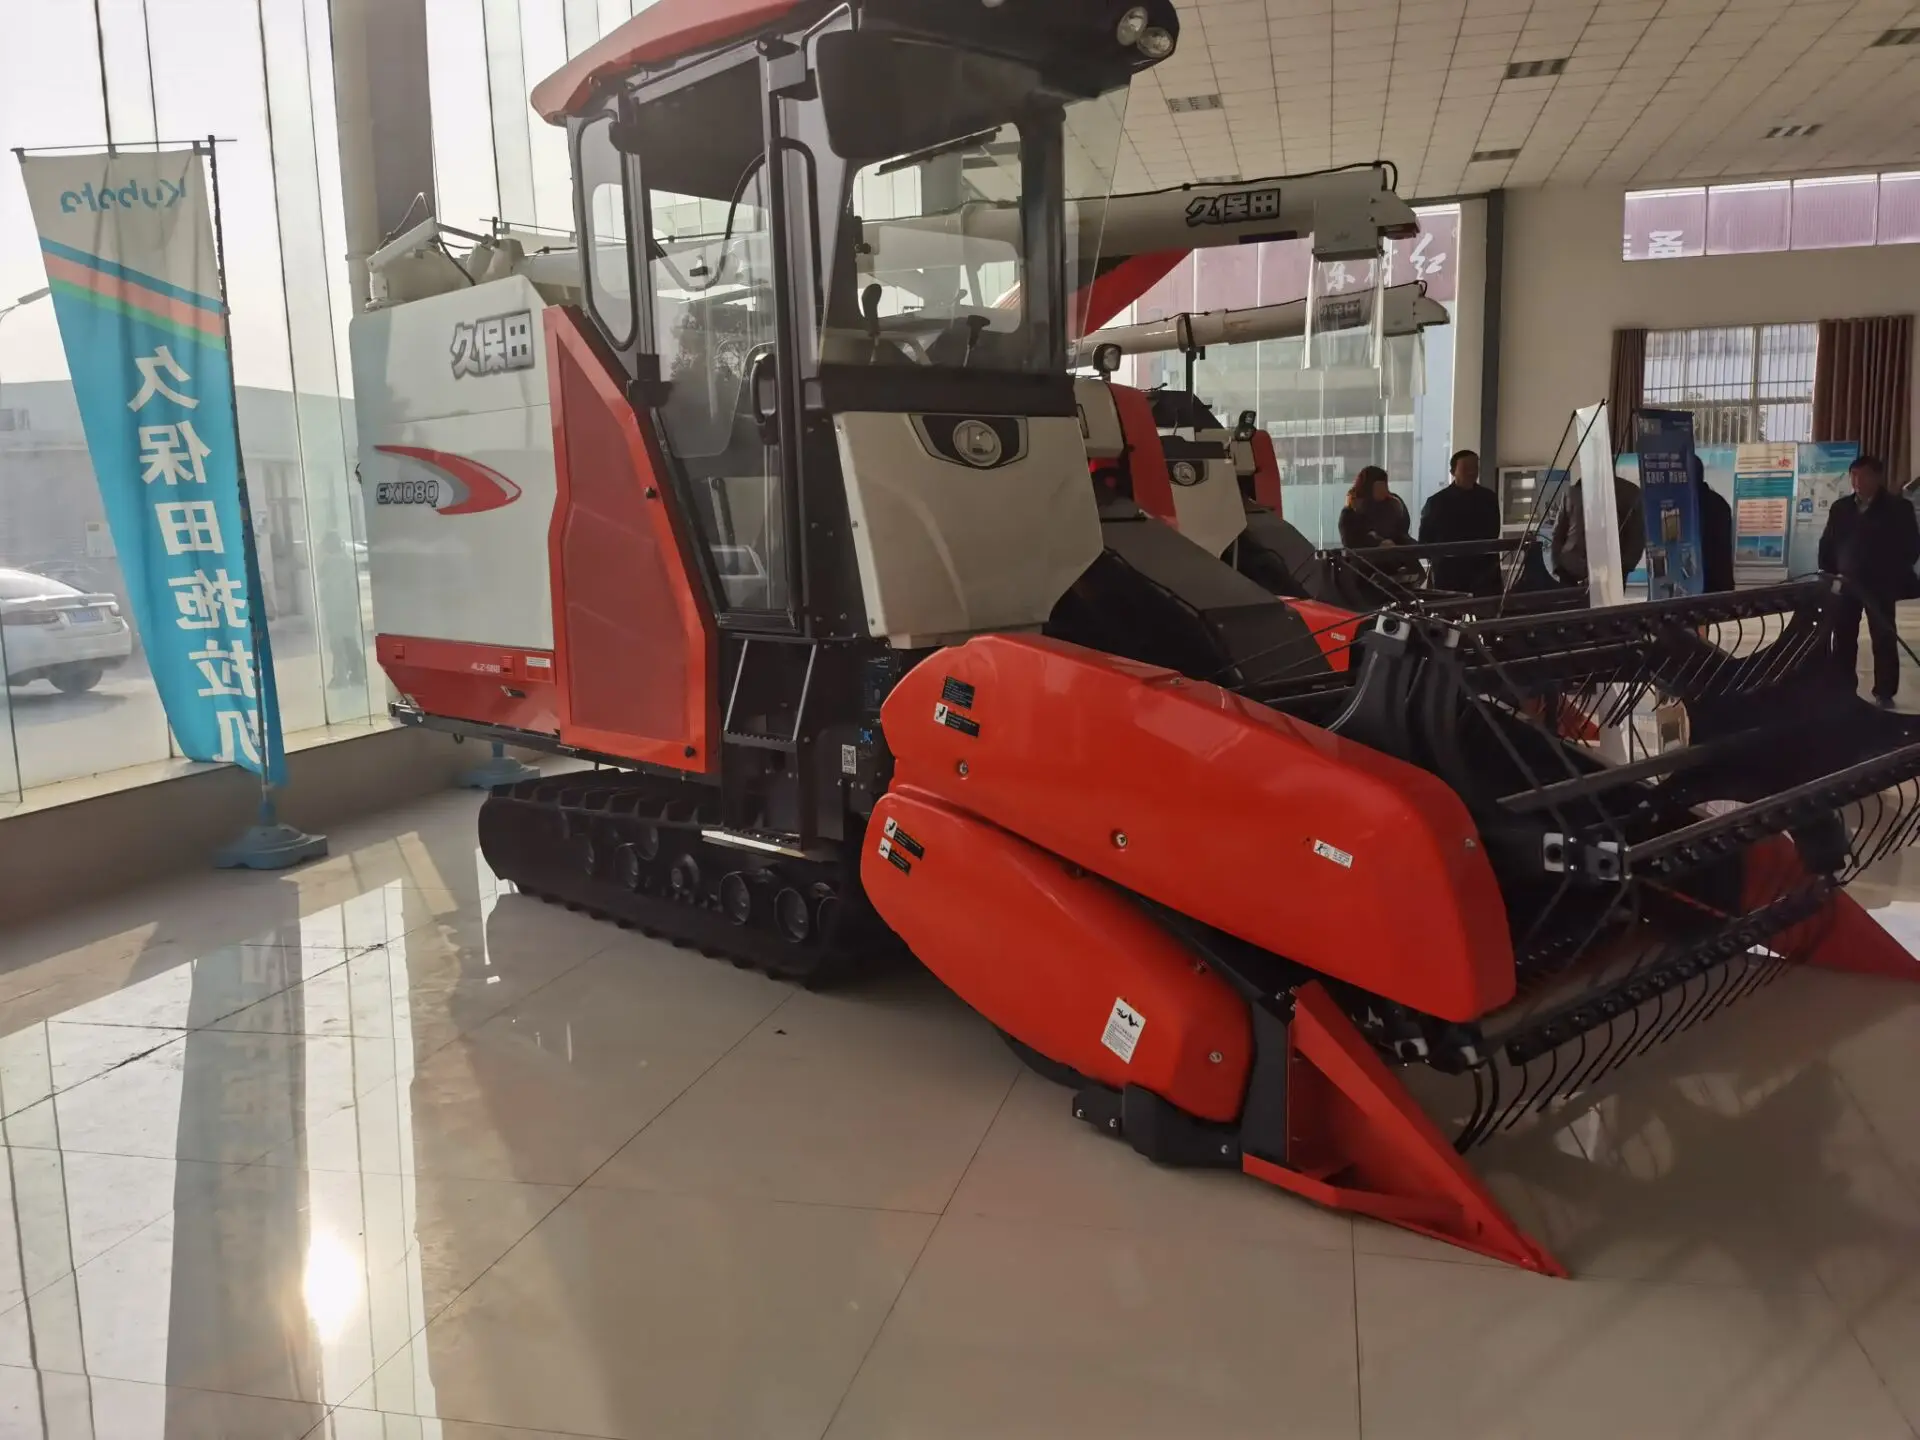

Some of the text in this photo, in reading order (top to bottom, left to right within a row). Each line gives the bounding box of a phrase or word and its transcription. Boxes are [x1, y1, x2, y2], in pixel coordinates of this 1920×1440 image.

[1185, 188, 1281, 228] 久保田
[450, 309, 535, 381] 久保田
[376, 480, 439, 507] EX108Q
